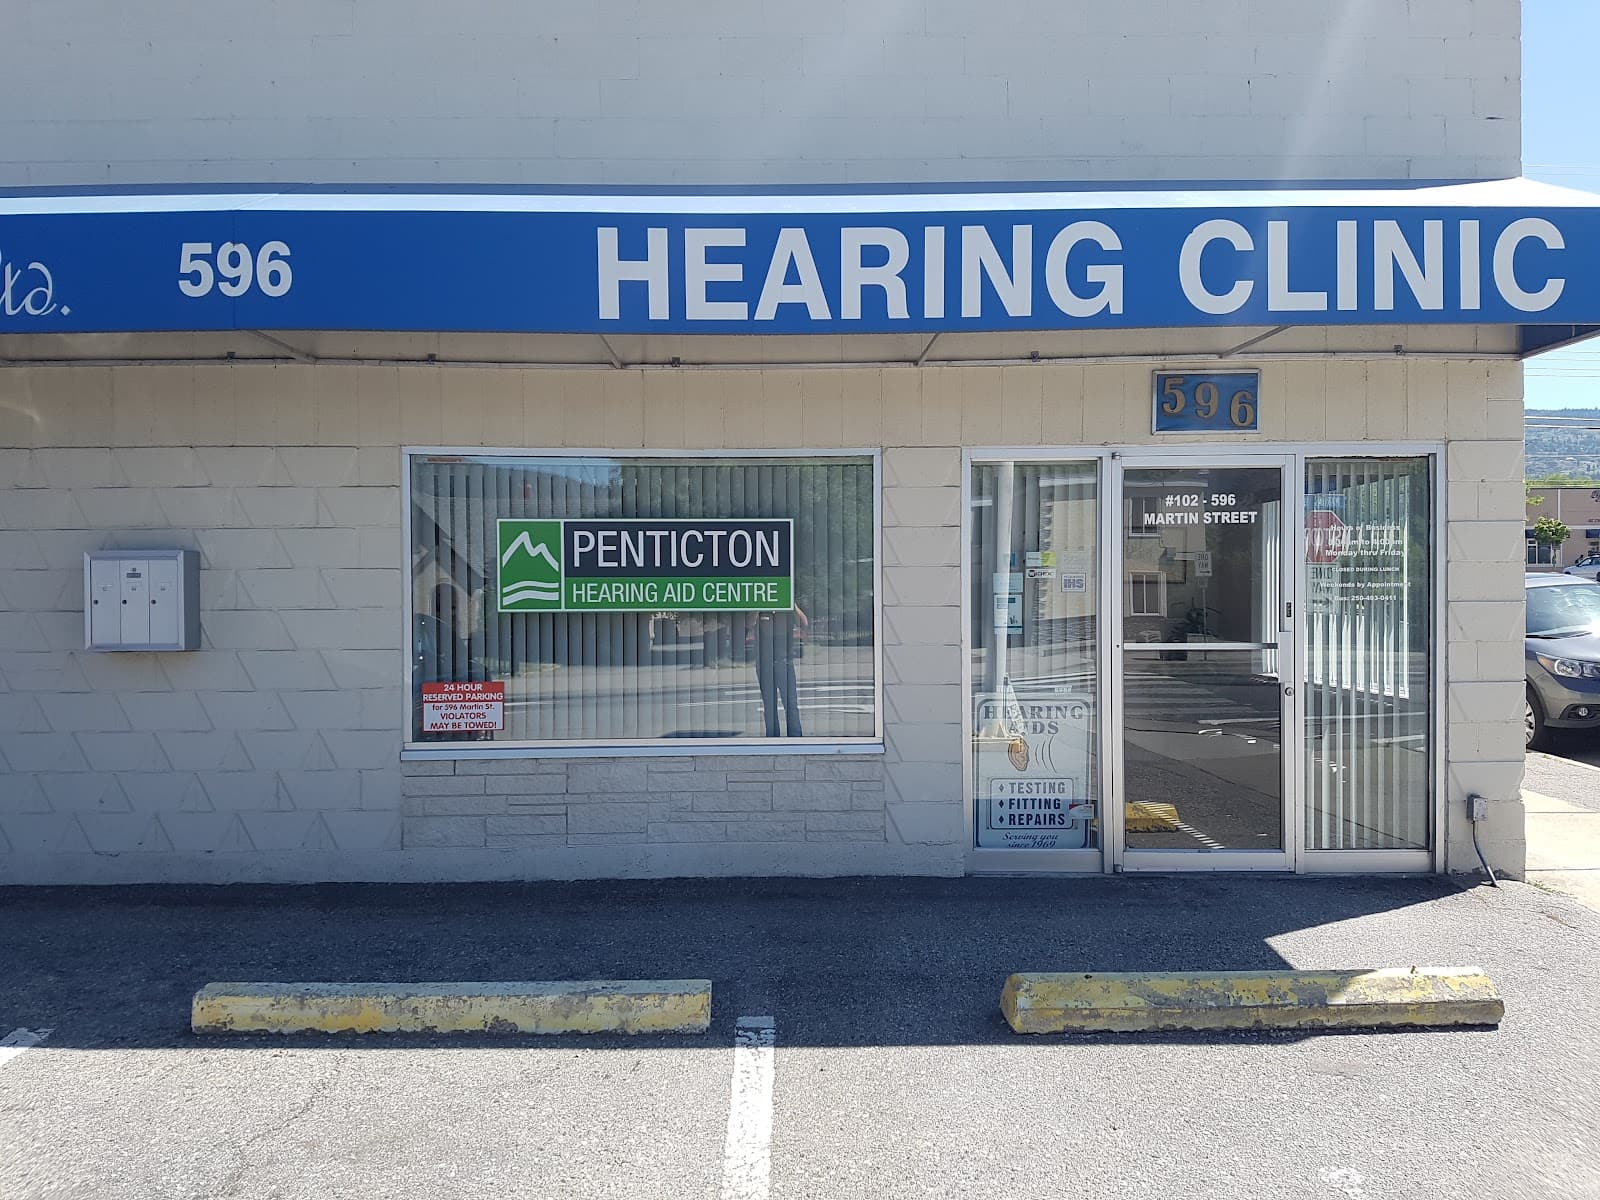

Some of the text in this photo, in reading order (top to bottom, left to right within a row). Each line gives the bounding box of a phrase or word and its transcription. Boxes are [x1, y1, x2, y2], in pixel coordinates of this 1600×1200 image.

[178, 240, 293, 298] 596
[597, 217, 1567, 321] HEARING CLINIC
[0, 249, 72, 316] td.
[1162, 377, 1255, 427] 596
[1165, 494, 1199, 507] #102
[1211, 493, 1236, 507] 596
[1144, 511, 1258, 525] MARTIN STREET
[573, 530, 780, 568] PENTICTON
[1325, 549, 1358, 558] Monday
[1380, 549, 1404, 558] Friday
[1063, 578, 1085, 589] IHS
[1357, 581, 1365, 589] by
[1366, 581, 1411, 589] Appointmet
[572, 582, 778, 603] HEARING AID CENTRE
[444, 683, 482, 692] 24 HOUR
[423, 692, 504, 702] RESERVED PARKING
[432, 702, 496, 711] for 596 Martin St.
[440, 712, 487, 720] VIOLATORS
[430, 721, 497, 730] MAY BE TOWED!
[1008, 781, 1066, 794] TESTING
[1008, 798, 1061, 810] FITTING
[1008, 813, 1065, 826] REPAIRS
[1002, 831, 1059, 843] Serving you
[1008, 840, 1056, 849] since 1969
